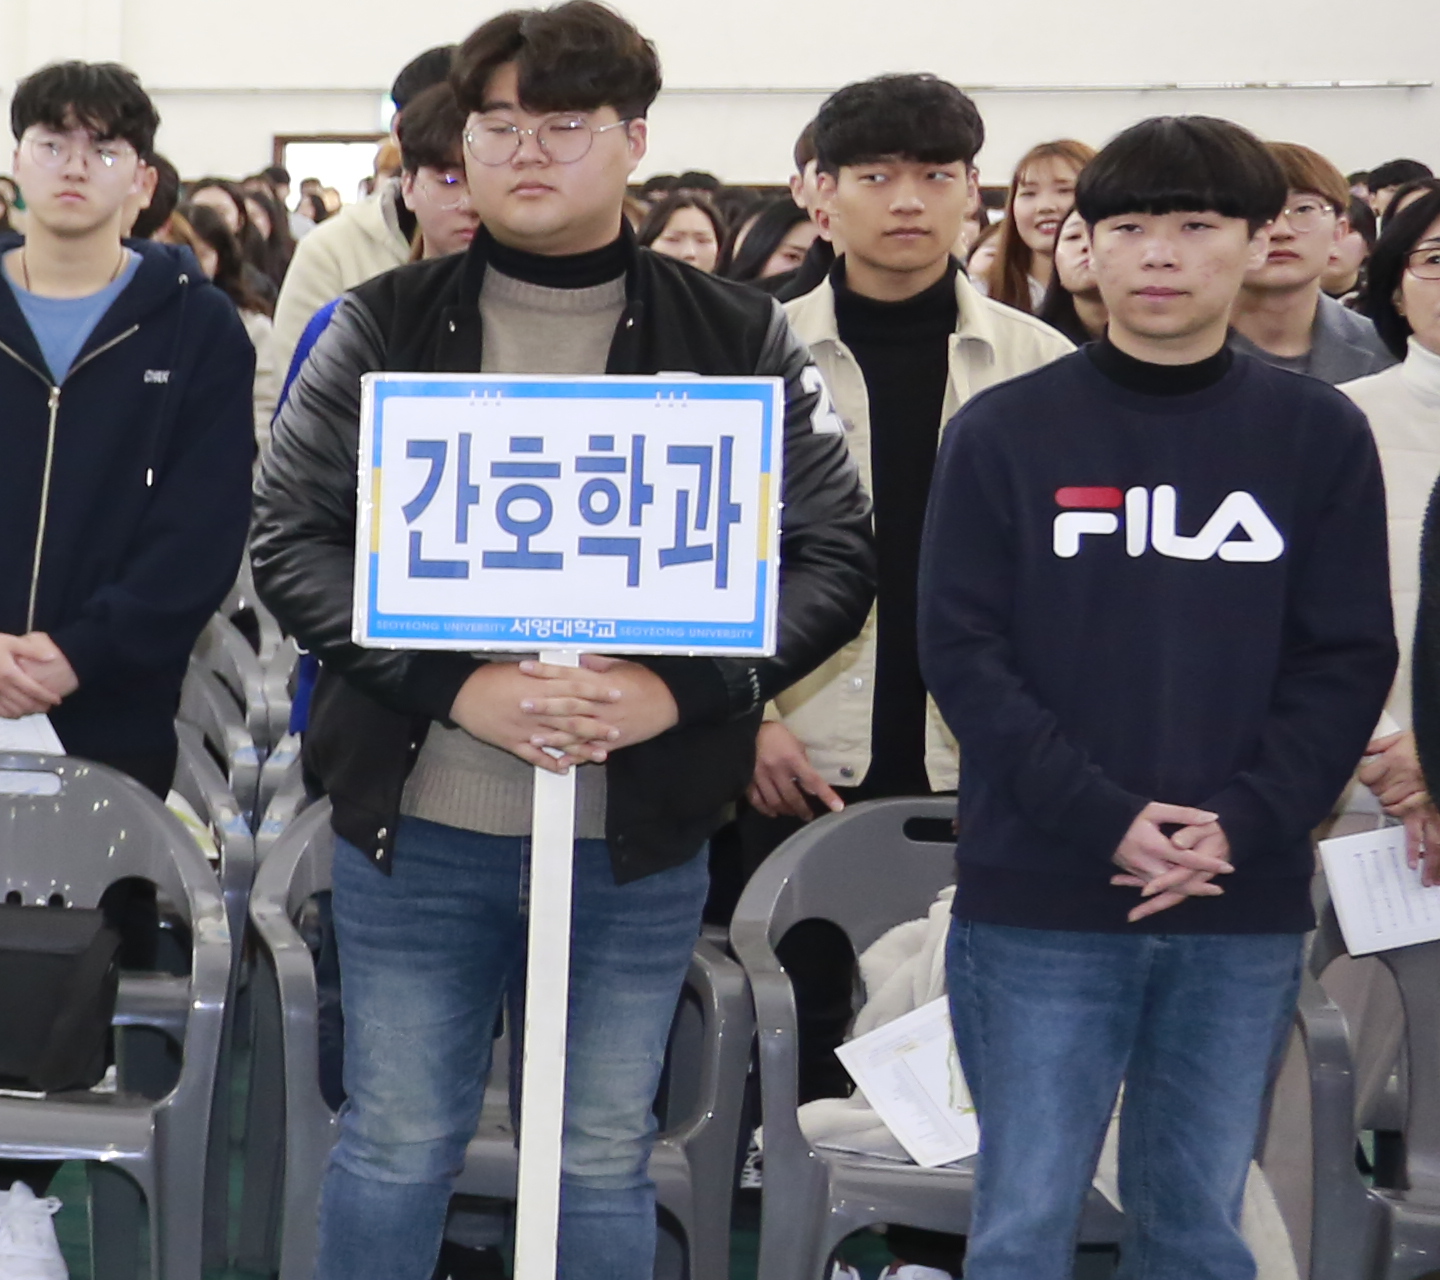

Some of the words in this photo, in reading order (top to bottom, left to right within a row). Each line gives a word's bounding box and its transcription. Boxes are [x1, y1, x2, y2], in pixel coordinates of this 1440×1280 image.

[401, 432, 742, 590] 간호학과
[1053, 484, 1285, 562] FILA
[376, 620, 440, 632] SEOYEONG
[443, 622, 507, 634] UNIVERSITY
[509, 618, 617, 638] 서영대학교
[620, 626, 685, 638] SEOYEONG
[689, 627, 754, 639] UNIVERSITY
